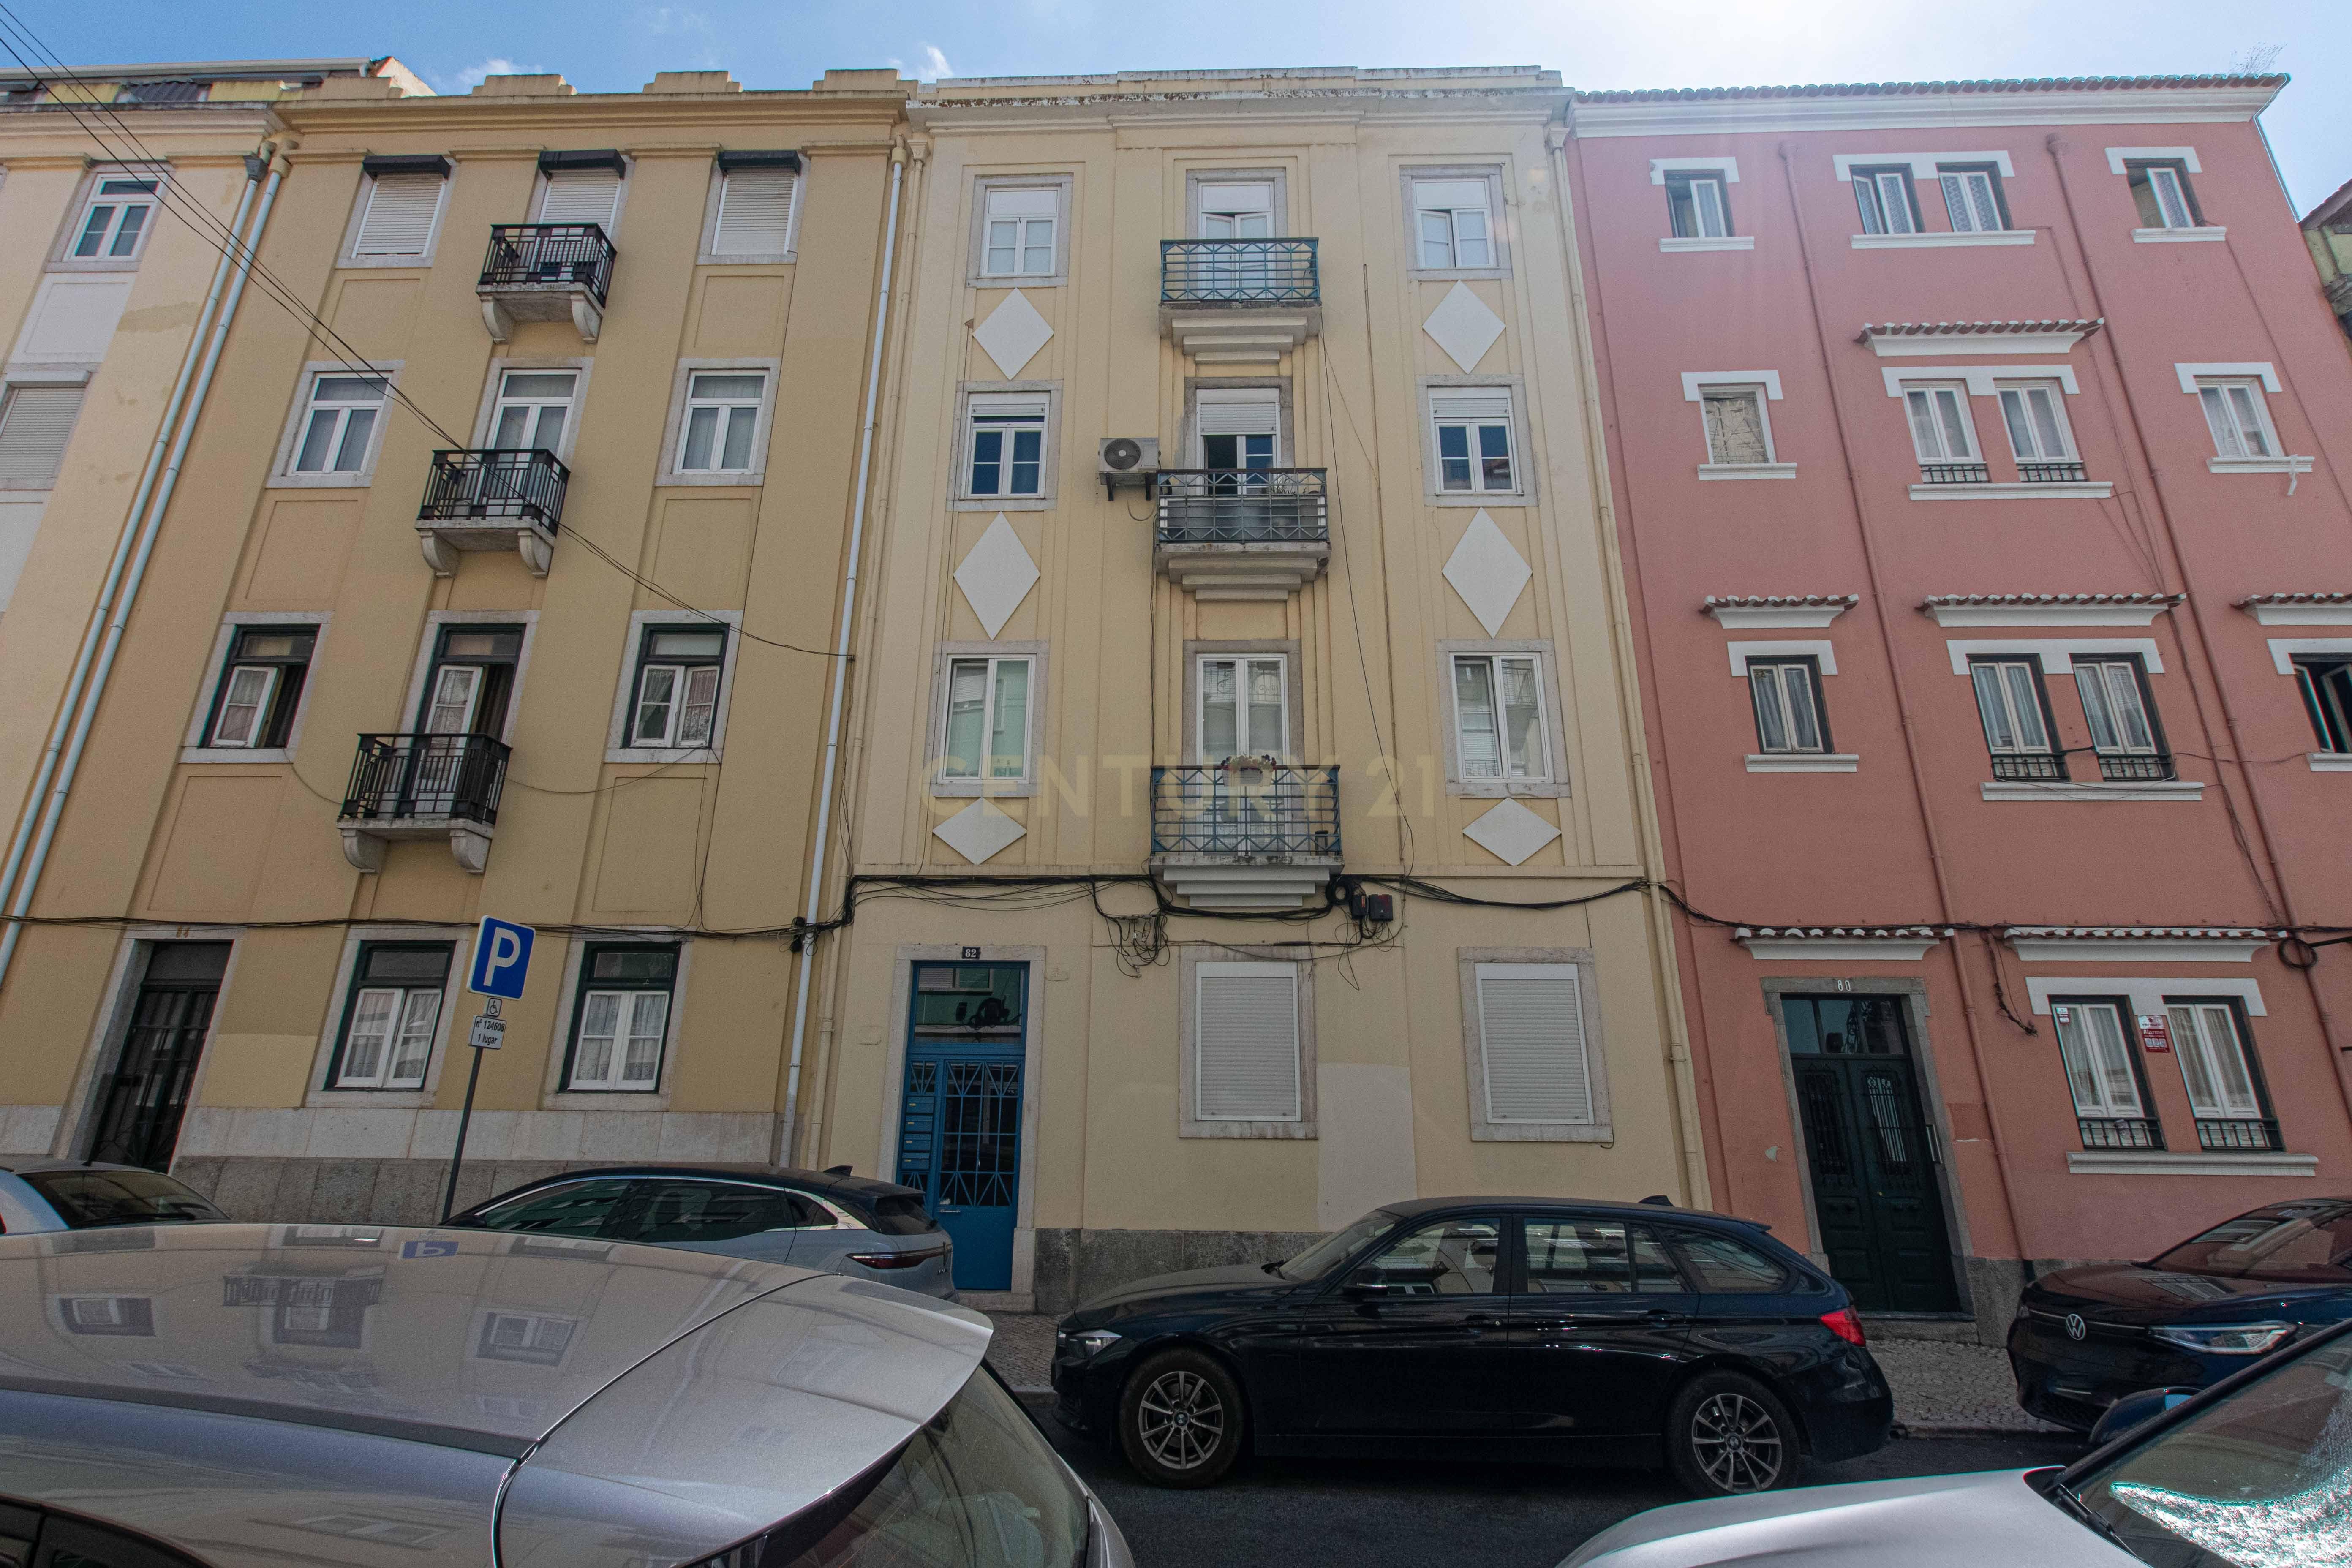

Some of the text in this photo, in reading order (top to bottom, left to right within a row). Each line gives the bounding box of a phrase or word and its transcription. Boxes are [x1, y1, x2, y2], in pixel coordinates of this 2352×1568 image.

[483, 927, 521, 986] P
[965, 949, 976, 958] 82
[1838, 980, 1851, 991] 80
[476, 1019, 505, 1032] nº 124608
[478, 1033, 498, 1045] 1 lugar
